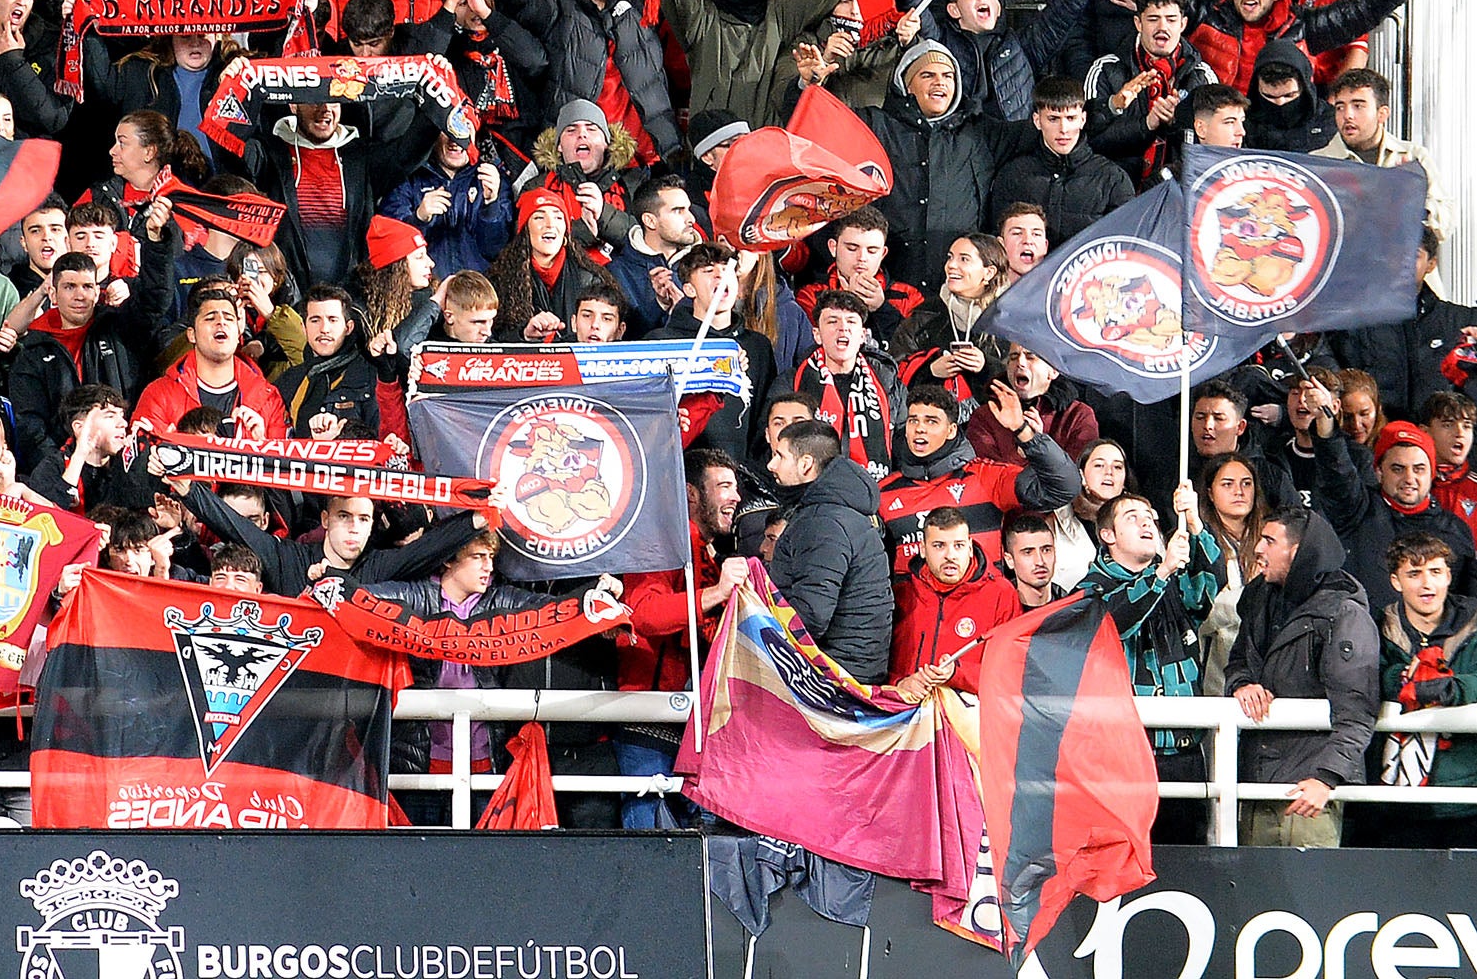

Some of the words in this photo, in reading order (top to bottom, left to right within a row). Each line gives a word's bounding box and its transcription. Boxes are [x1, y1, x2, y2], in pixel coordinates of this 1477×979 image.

[457, 367, 563, 382] MIRANDES
[193, 451, 309, 491] ORGULLO
[312, 462, 346, 493] DE
[352, 466, 452, 504] PUEBLO
[465, 631, 541, 650] ANDUVA
[71, 910, 129, 932] CLUB
